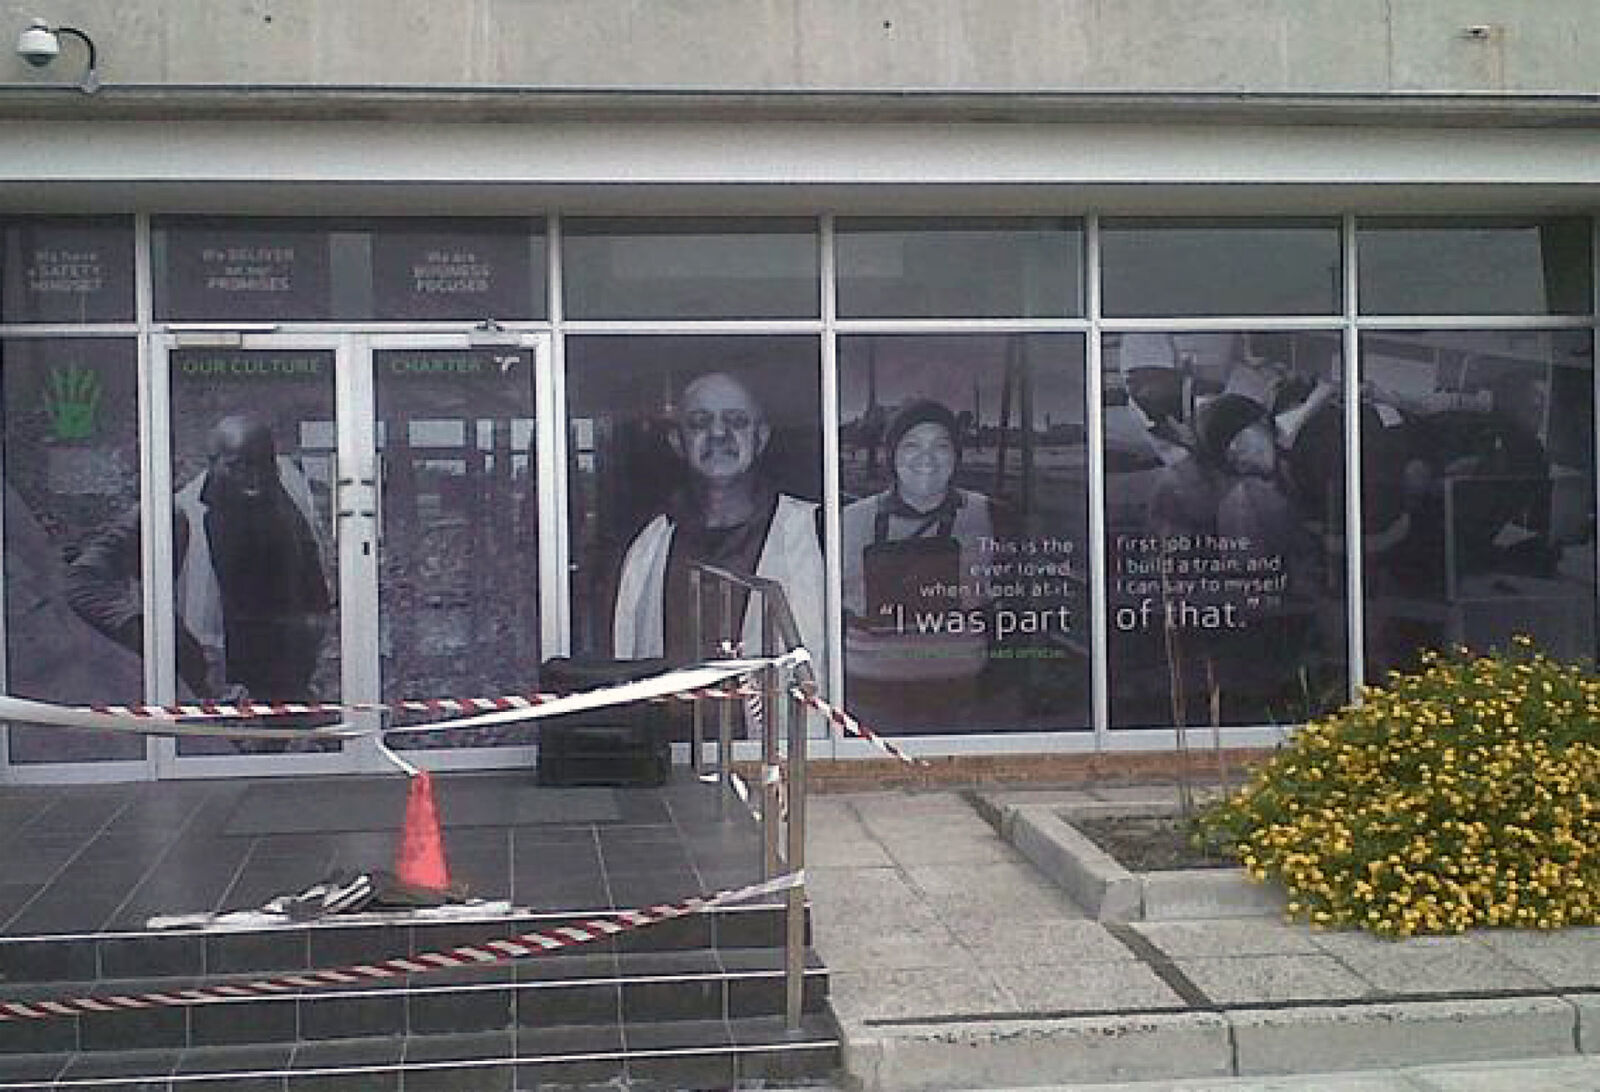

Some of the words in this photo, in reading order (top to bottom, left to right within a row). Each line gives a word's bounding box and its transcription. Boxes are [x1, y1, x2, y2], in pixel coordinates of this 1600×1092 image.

[183, 358, 227, 373] OUR
[231, 358, 321, 373] CULTURE
[976, 536, 1017, 554] This
[1021, 536, 1037, 554] is
[1042, 536, 1074, 554] the
[1206, 535, 1251, 551] have
[969, 562, 1014, 577] ever
[1127, 556, 1175, 574] build
[1178, 559, 1189, 573] a
[1246, 555, 1283, 572] and
[918, 580, 972, 597] when
[984, 580, 1025, 597] look
[1126, 580, 1161, 595] can
[1200, 577, 1220, 592] to
[1224, 573, 1288, 596] myself
[914, 609, 987, 634] was
[995, 604, 1072, 641] part
[1116, 597, 1152, 631] of
